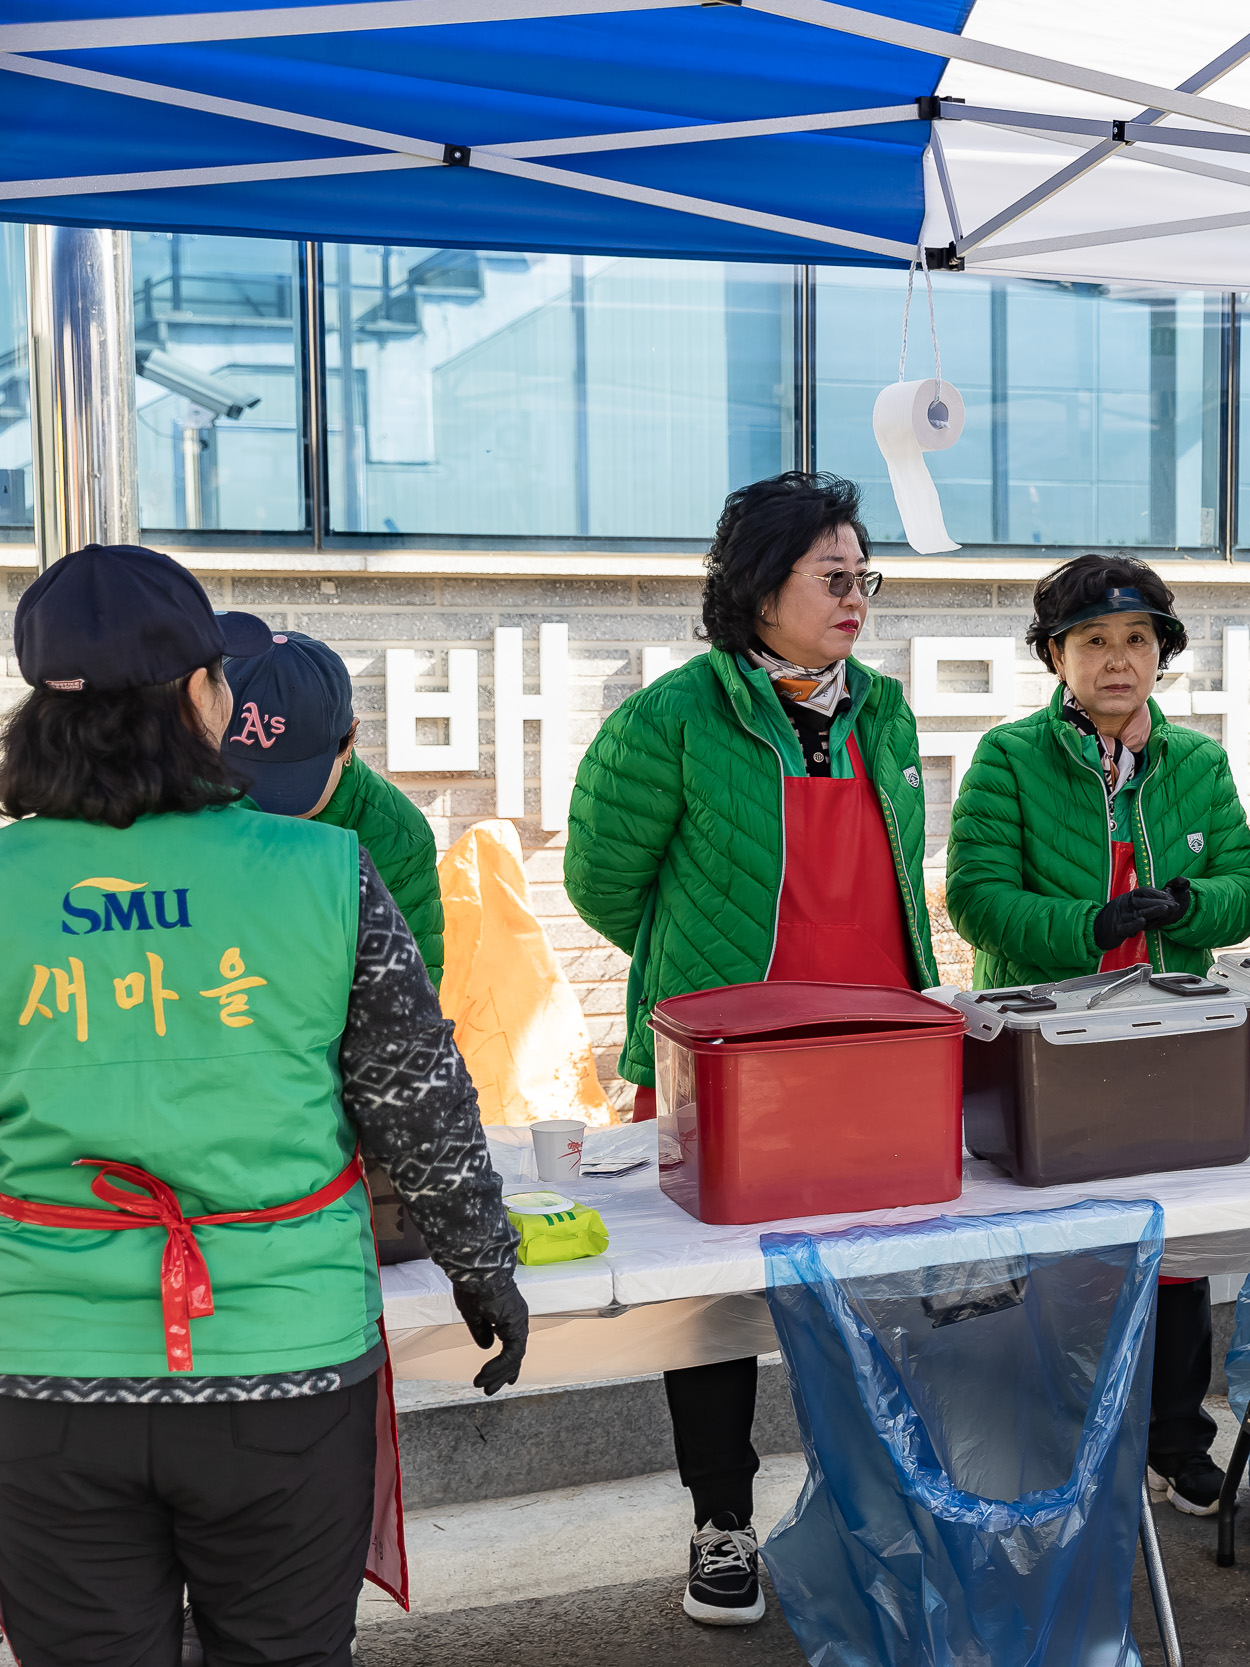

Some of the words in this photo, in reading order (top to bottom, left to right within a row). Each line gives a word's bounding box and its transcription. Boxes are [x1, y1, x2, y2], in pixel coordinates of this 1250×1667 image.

[230, 701, 286, 749] A's
[62, 888, 193, 935] SMU
[18, 947, 268, 1043] 새마을
